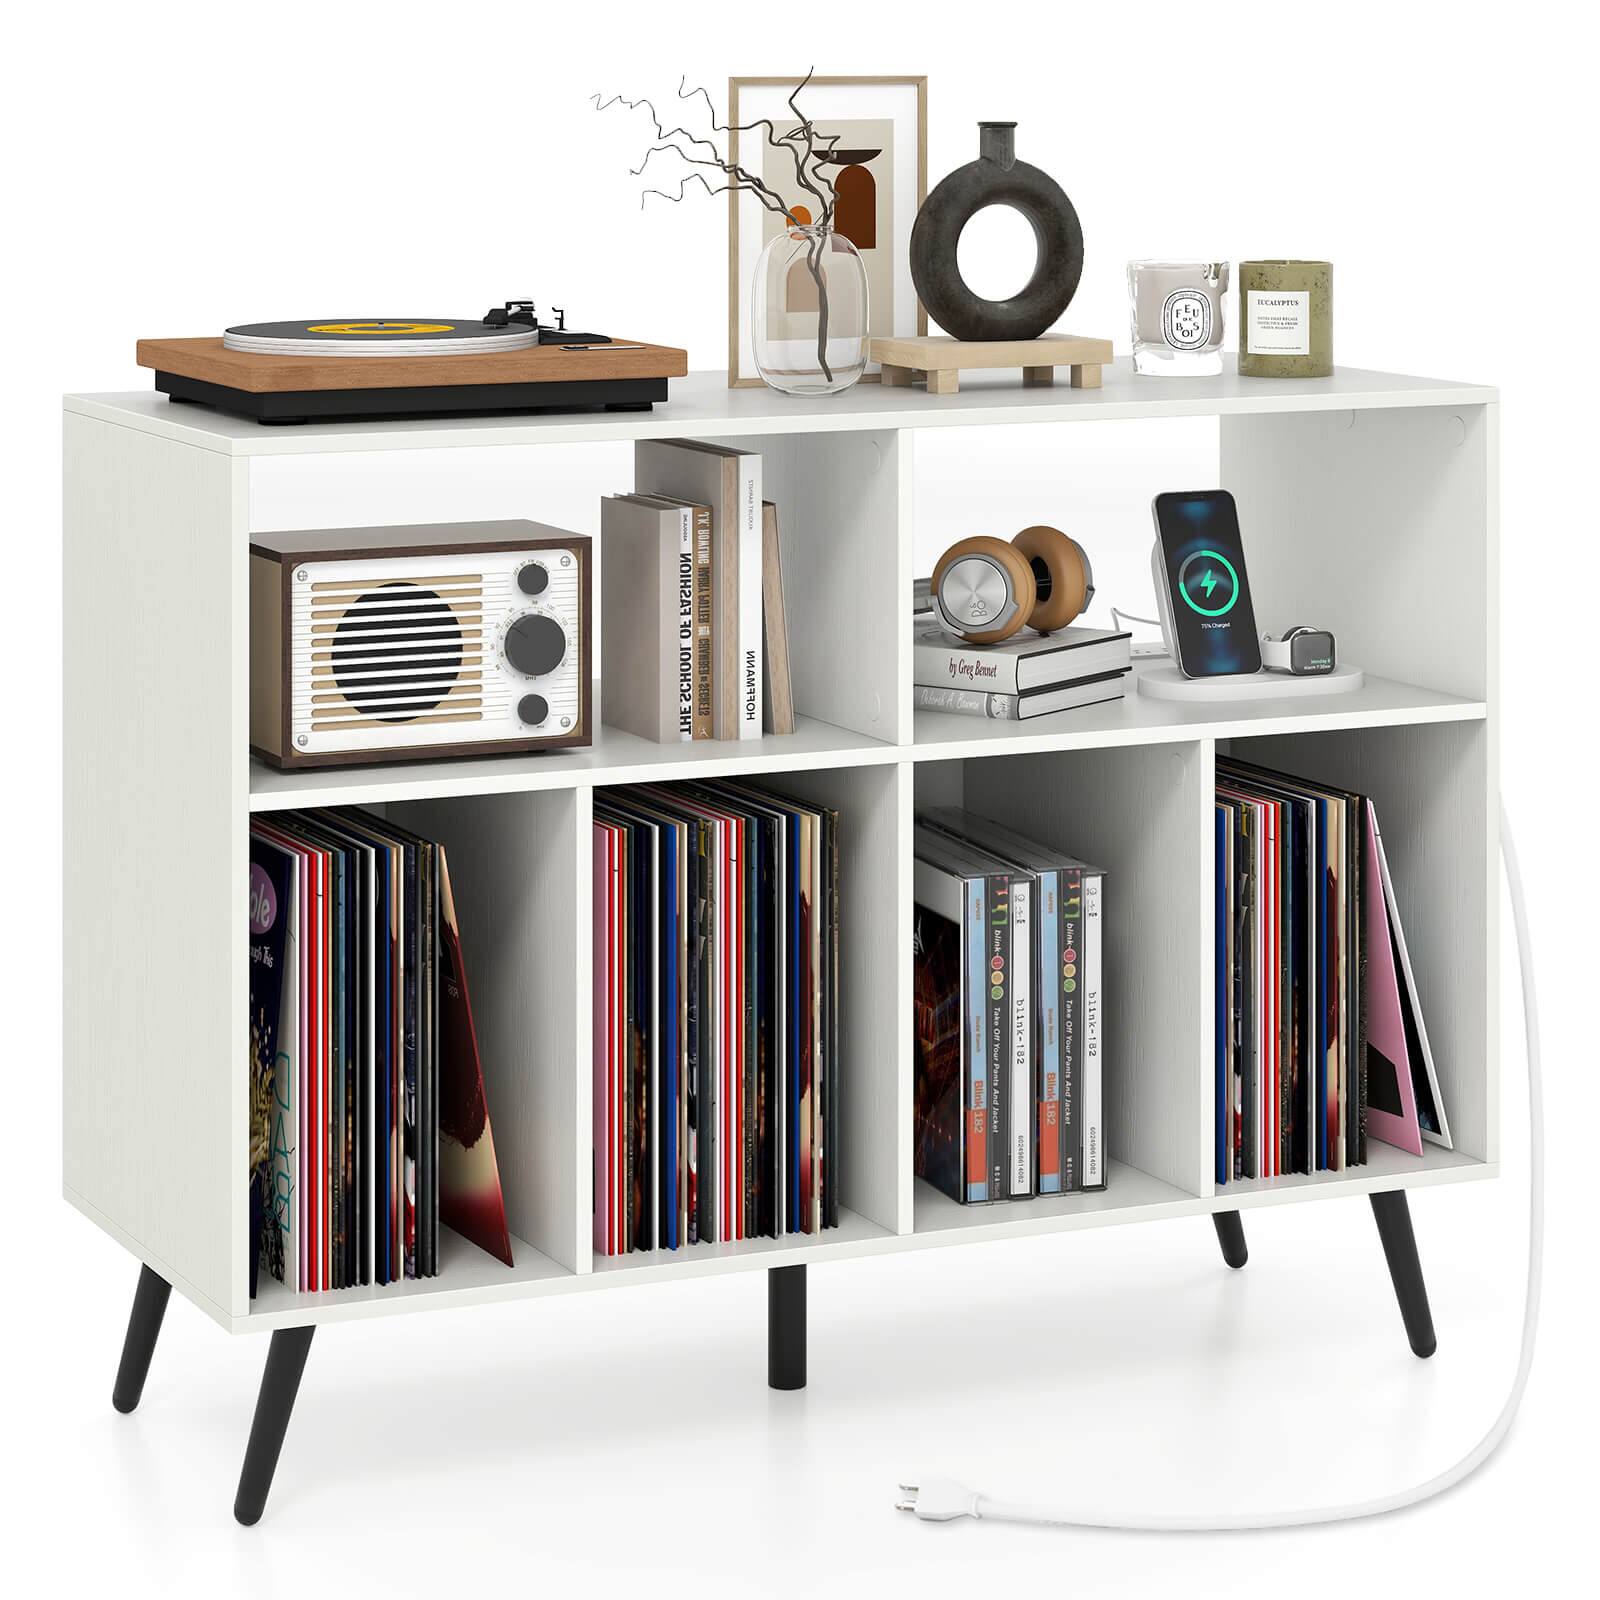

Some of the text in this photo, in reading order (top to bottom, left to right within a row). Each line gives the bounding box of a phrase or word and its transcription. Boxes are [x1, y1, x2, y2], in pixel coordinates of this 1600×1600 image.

[1176, 304, 1200, 318] FEU
[949, 658, 997, 681] by Greg Bennet
[991, 1006, 1002, 1027] Take
[1064, 999, 1074, 1020] Take
[991, 1028, 1002, 1041] Off
[1015, 998, 1026, 1065] blink-182
[1064, 1021, 1074, 1034] Off
[1088, 991, 1098, 1057] blink-182
[990, 1042, 1001, 1062] Your
[1063, 1035, 1074, 1054] Your
[990, 1063, 1001, 1086] Pants
[1063, 1055, 1074, 1078] Pants
[990, 1087, 1001, 1105] And
[1045, 1072, 1057, 1126] Blink 182
[1063, 1079, 1074, 1097] And
[973, 1080, 985, 1134] Blink 182
[1063, 1098, 1074, 1125] Jacket
[990, 1106, 1001, 1134] Jacket
